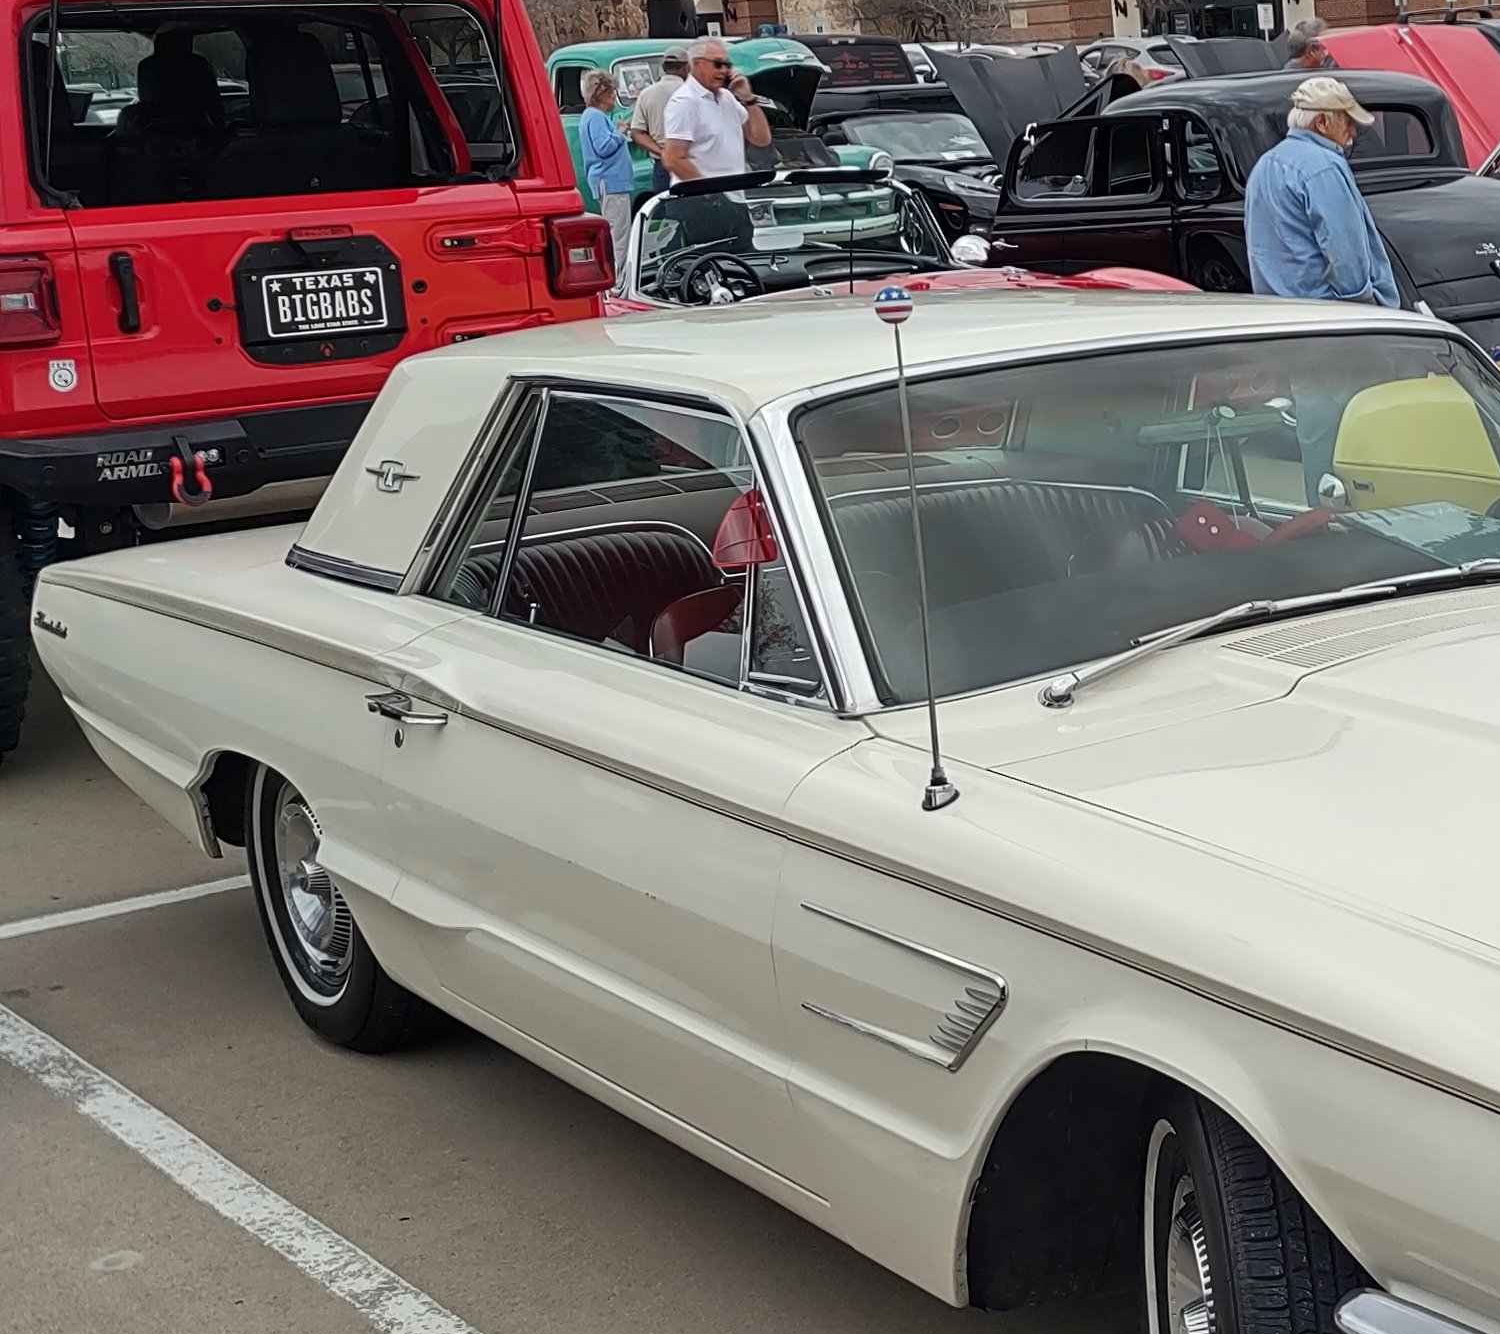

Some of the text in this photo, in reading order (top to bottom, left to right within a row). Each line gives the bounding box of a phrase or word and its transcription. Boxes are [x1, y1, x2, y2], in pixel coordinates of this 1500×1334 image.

[292, 274, 354, 291] TEXAS
[277, 288, 374, 323] BIGBABS
[96, 449, 154, 468] ROAD
